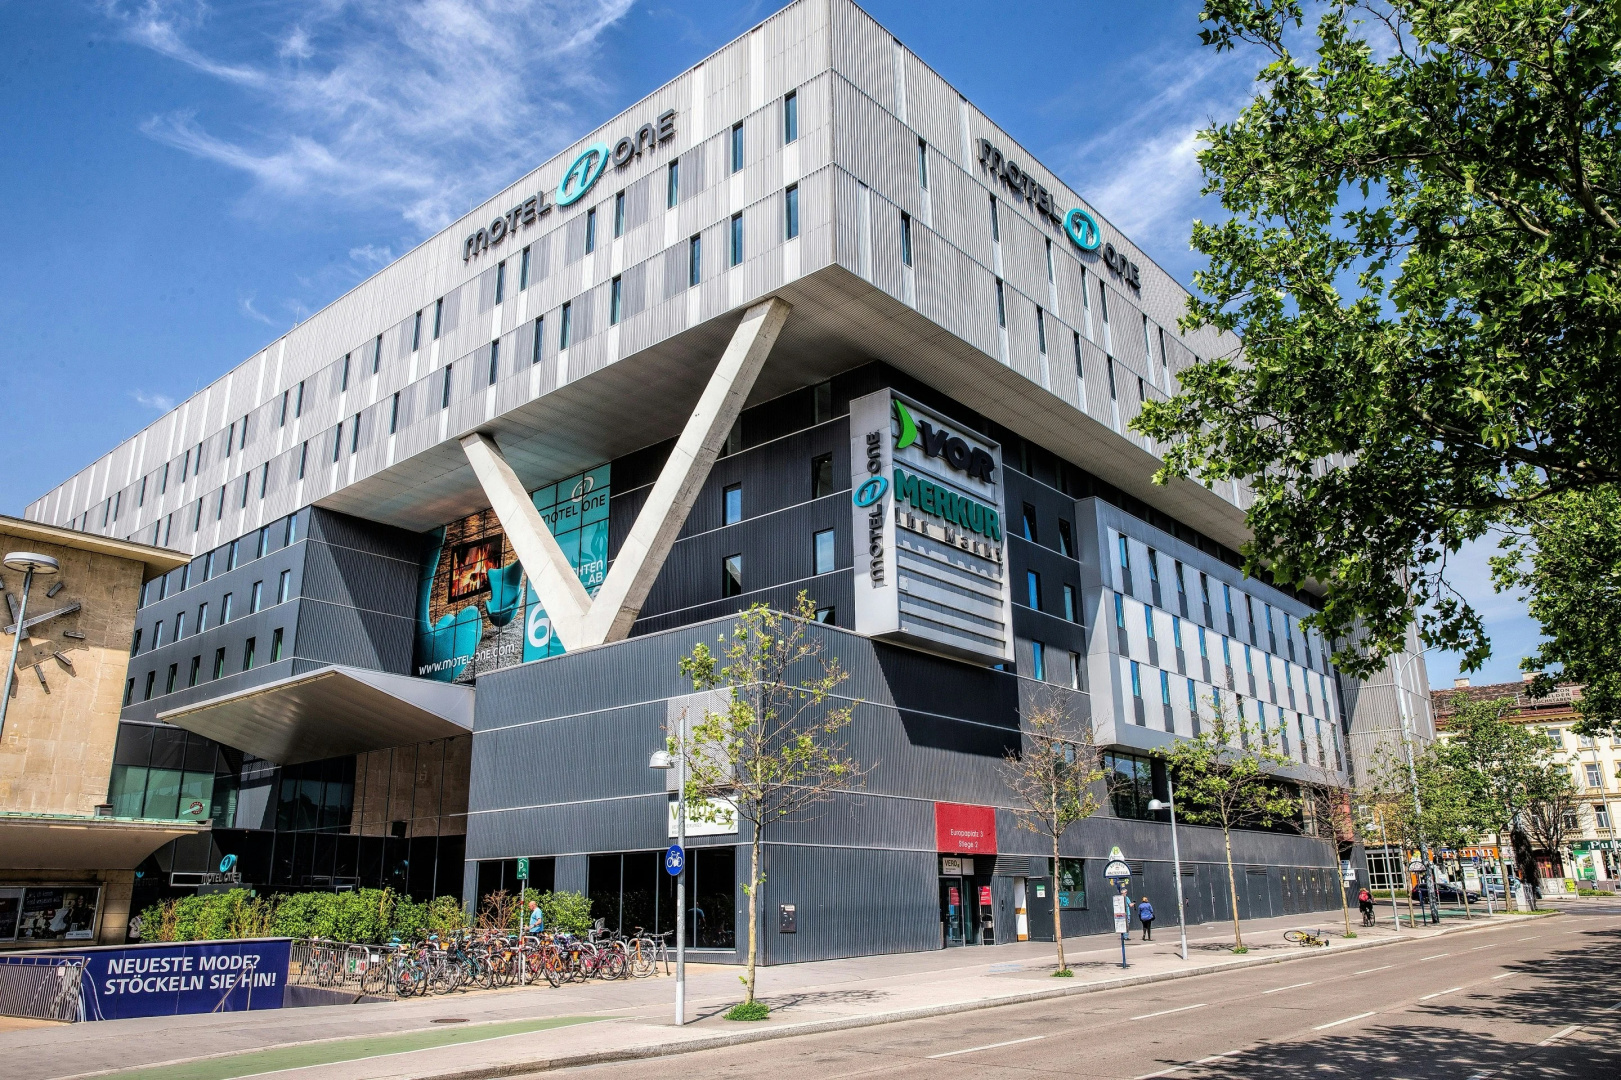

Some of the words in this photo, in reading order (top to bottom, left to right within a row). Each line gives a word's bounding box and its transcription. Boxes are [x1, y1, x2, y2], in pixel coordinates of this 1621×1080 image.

[918, 419, 996, 485] VOR
[893, 467, 1002, 542] MERKUR
[894, 506, 929, 534] Ihr
[587, 571, 603, 586] AB
[950, 828, 979, 838] Europaplatz
[958, 841, 974, 849] Stiege
[107, 956, 194, 975] NEUESTE
[199, 954, 261, 972] MODE?
[104, 974, 204, 995] STÖCKELN
[209, 974, 236, 989] SIE
[241, 972, 277, 988] HIN!
